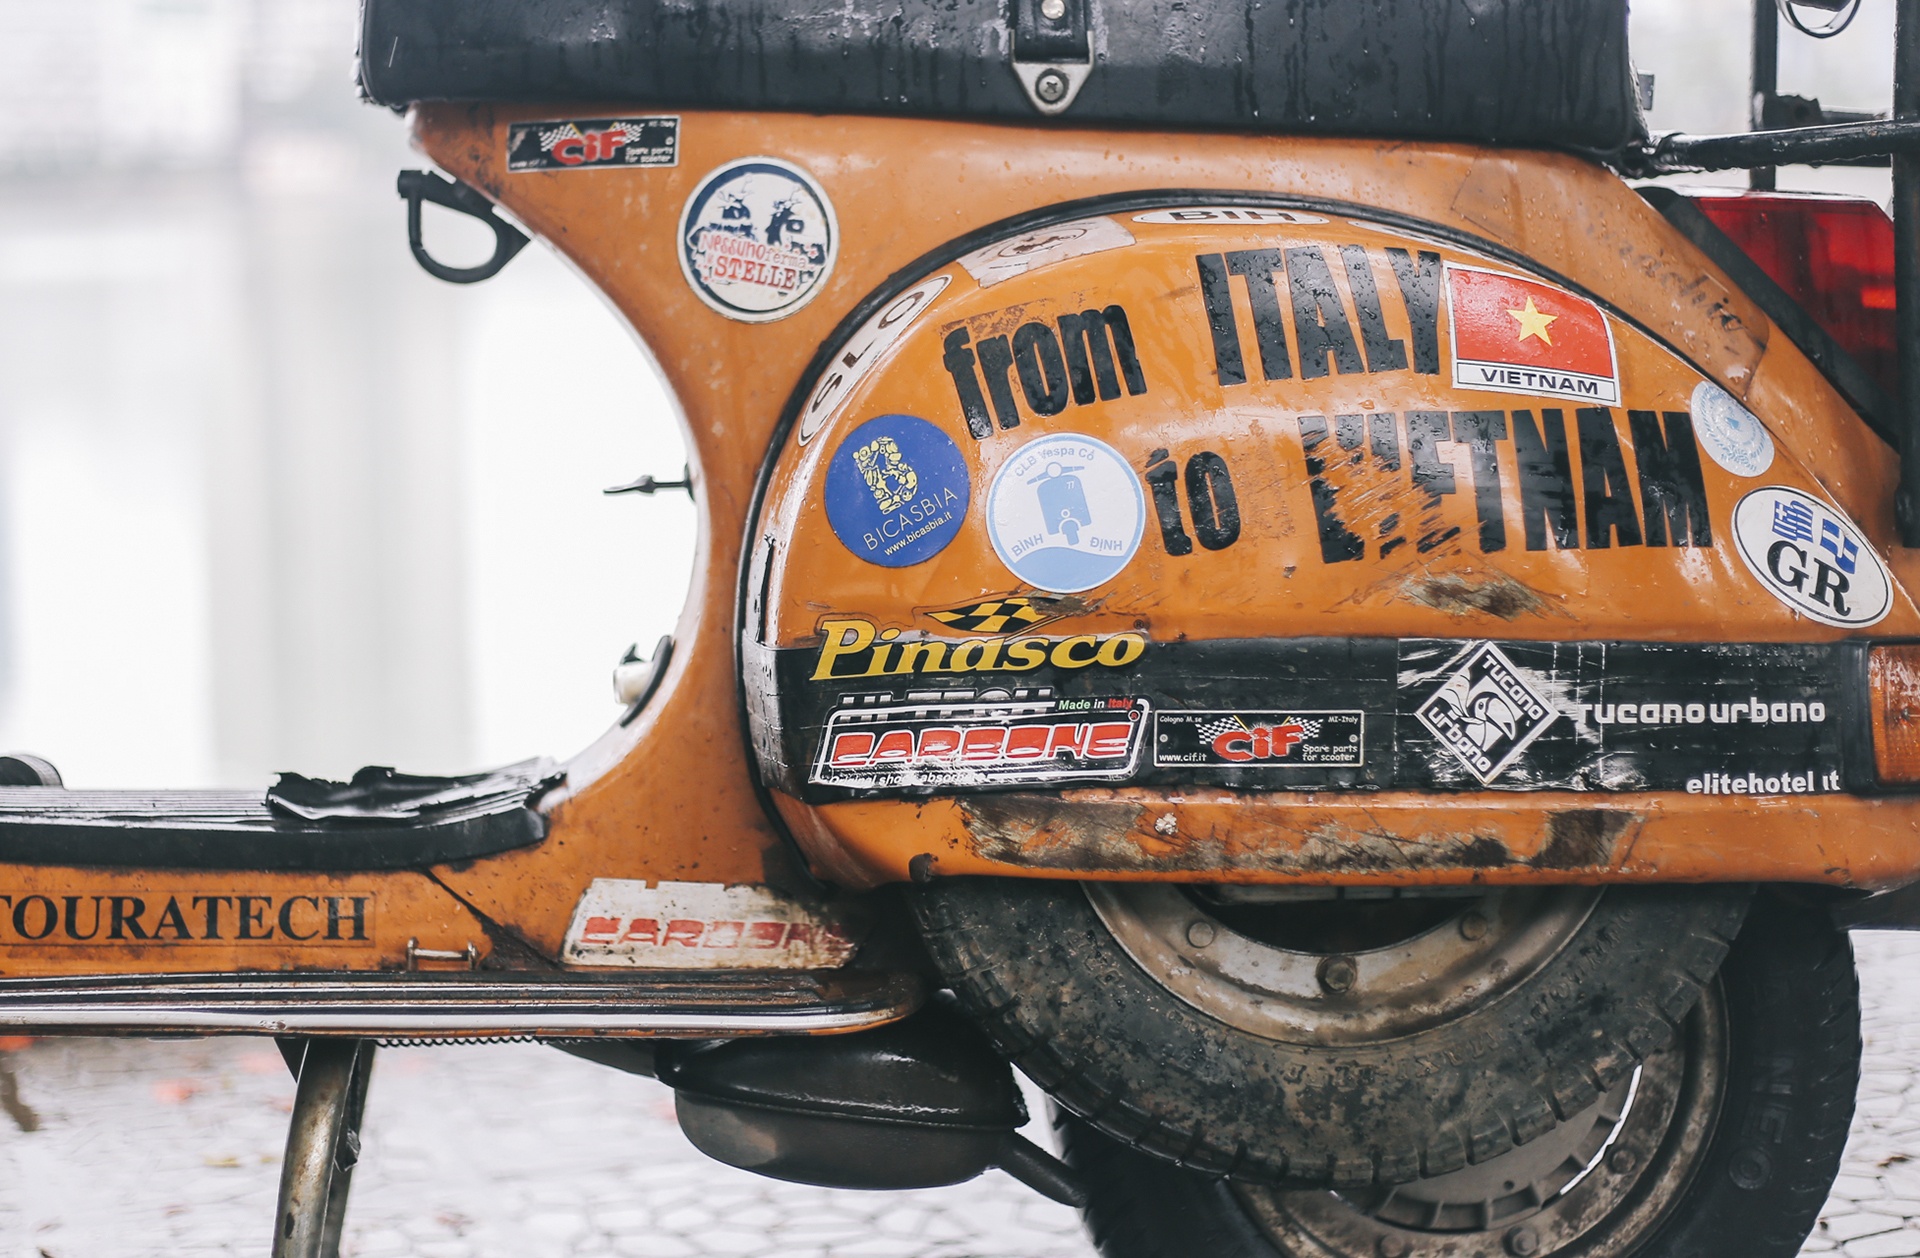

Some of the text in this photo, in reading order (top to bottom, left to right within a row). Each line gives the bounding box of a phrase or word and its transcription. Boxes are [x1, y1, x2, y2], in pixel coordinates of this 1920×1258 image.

[640, 153, 672, 163] scooter
[1169, 209, 1297, 222] BIH
[714, 255, 797, 291] STELLE
[811, 291, 926, 414] SLO
[942, 244, 1441, 441] from ITALY
[1480, 367, 1600, 396] VIETNAM
[1014, 455, 1038, 478] CLB
[1038, 446, 1076, 460] Vespa
[863, 486, 958, 551] BICASBIA
[1144, 447, 1241, 557] to
[884, 511, 953, 556] www.bicasbia.it
[1766, 539, 1850, 617] GR
[809, 618, 1147, 681] Pinasco
[1058, 697, 1134, 711] Made in Italy
[1159, 715, 1184, 724] Cologno
[1328, 715, 1359, 725] MI-Italy
[830, 721, 1135, 768] CARBONE
[1159, 752, 1208, 763] www.cif.it
[1302, 743, 1358, 754] Spare parts
[1302, 752, 1356, 762] for scooter
[580, 915, 854, 951] CARBON
